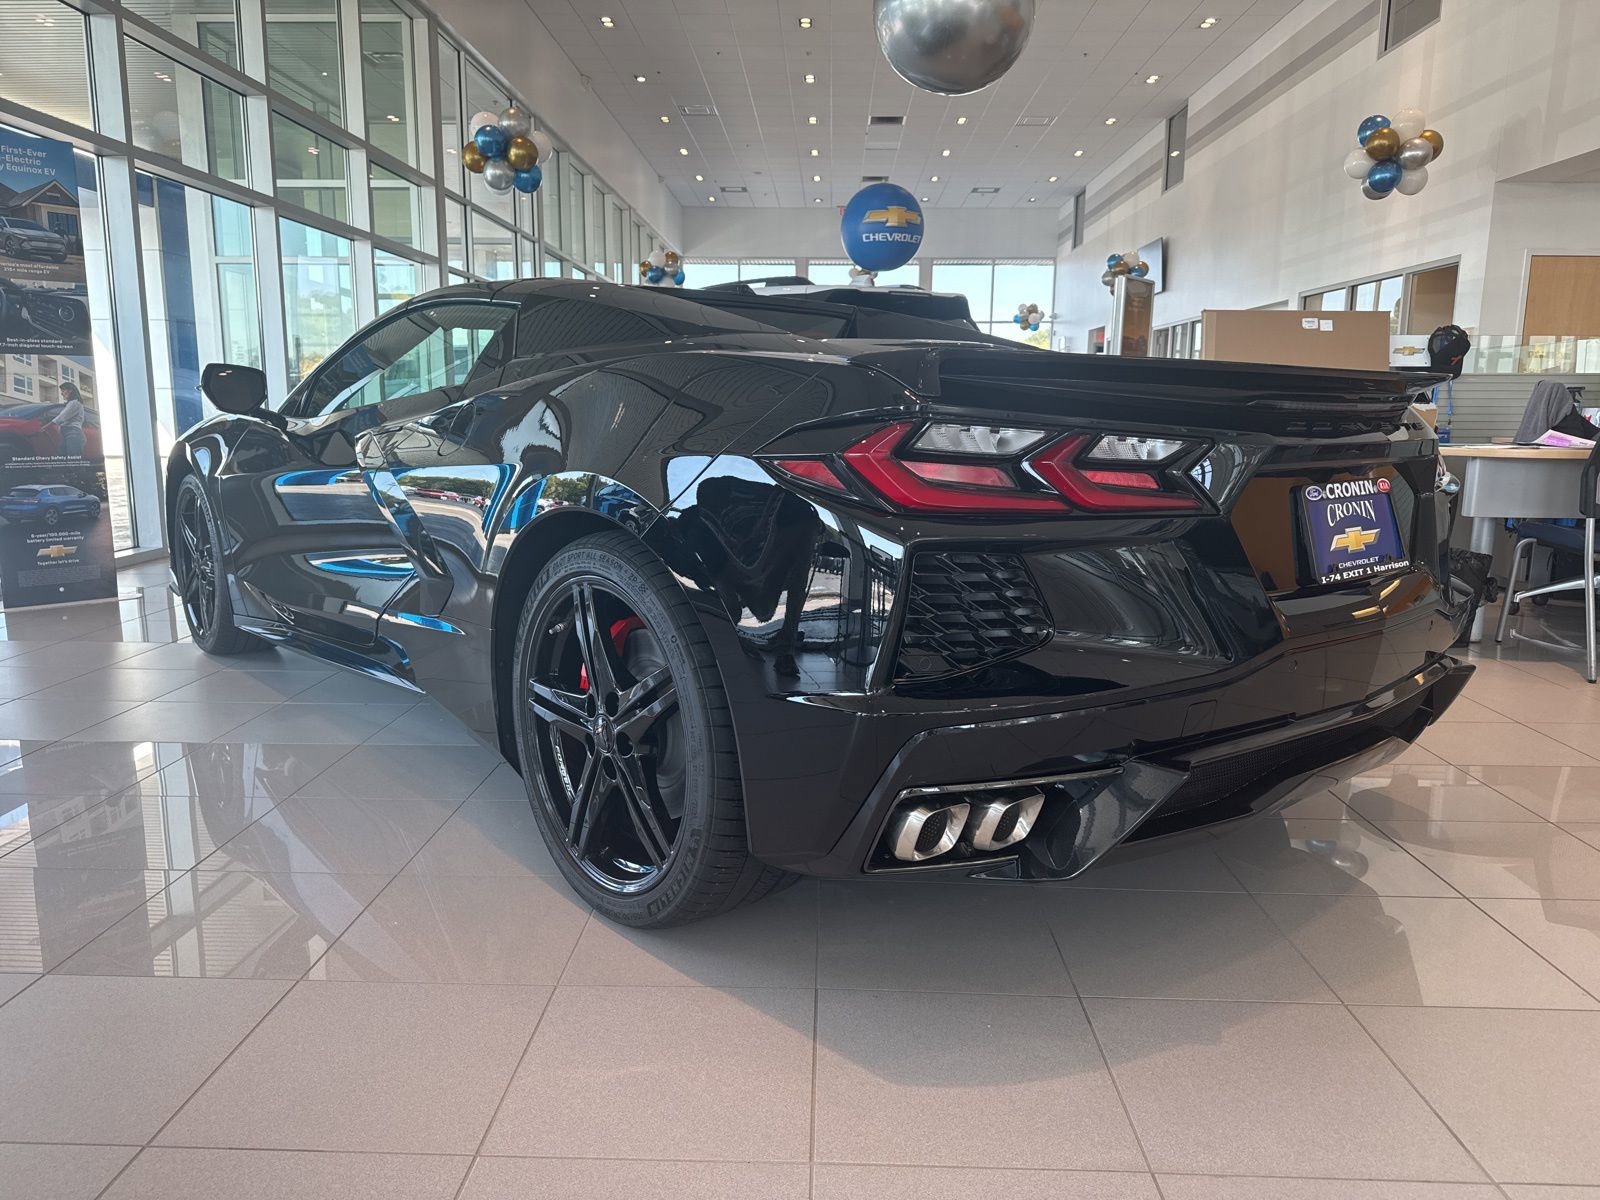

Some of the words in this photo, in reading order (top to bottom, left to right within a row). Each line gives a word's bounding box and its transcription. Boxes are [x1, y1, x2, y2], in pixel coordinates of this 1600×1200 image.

[1, 145, 48, 158] First-Ever
[6, 163, 43, 175] Equinox
[44, 168, 56, 176] EV
[862, 232, 922, 244] CHEVROLET
[1325, 480, 1374, 499] CRONIN
[1327, 500, 1376, 527] CRONIN
[567, 551, 585, 562] SPORT
[586, 551, 597, 561] ALL
[599, 552, 623, 572] SEASON
[1338, 557, 1379, 569] CHEVROLET
[1321, 573, 1341, 584] I-74
[1343, 568, 1364, 579] EXIT
[1366, 566, 1372, 574] 1
[1373, 560, 1409, 573] Harrison
